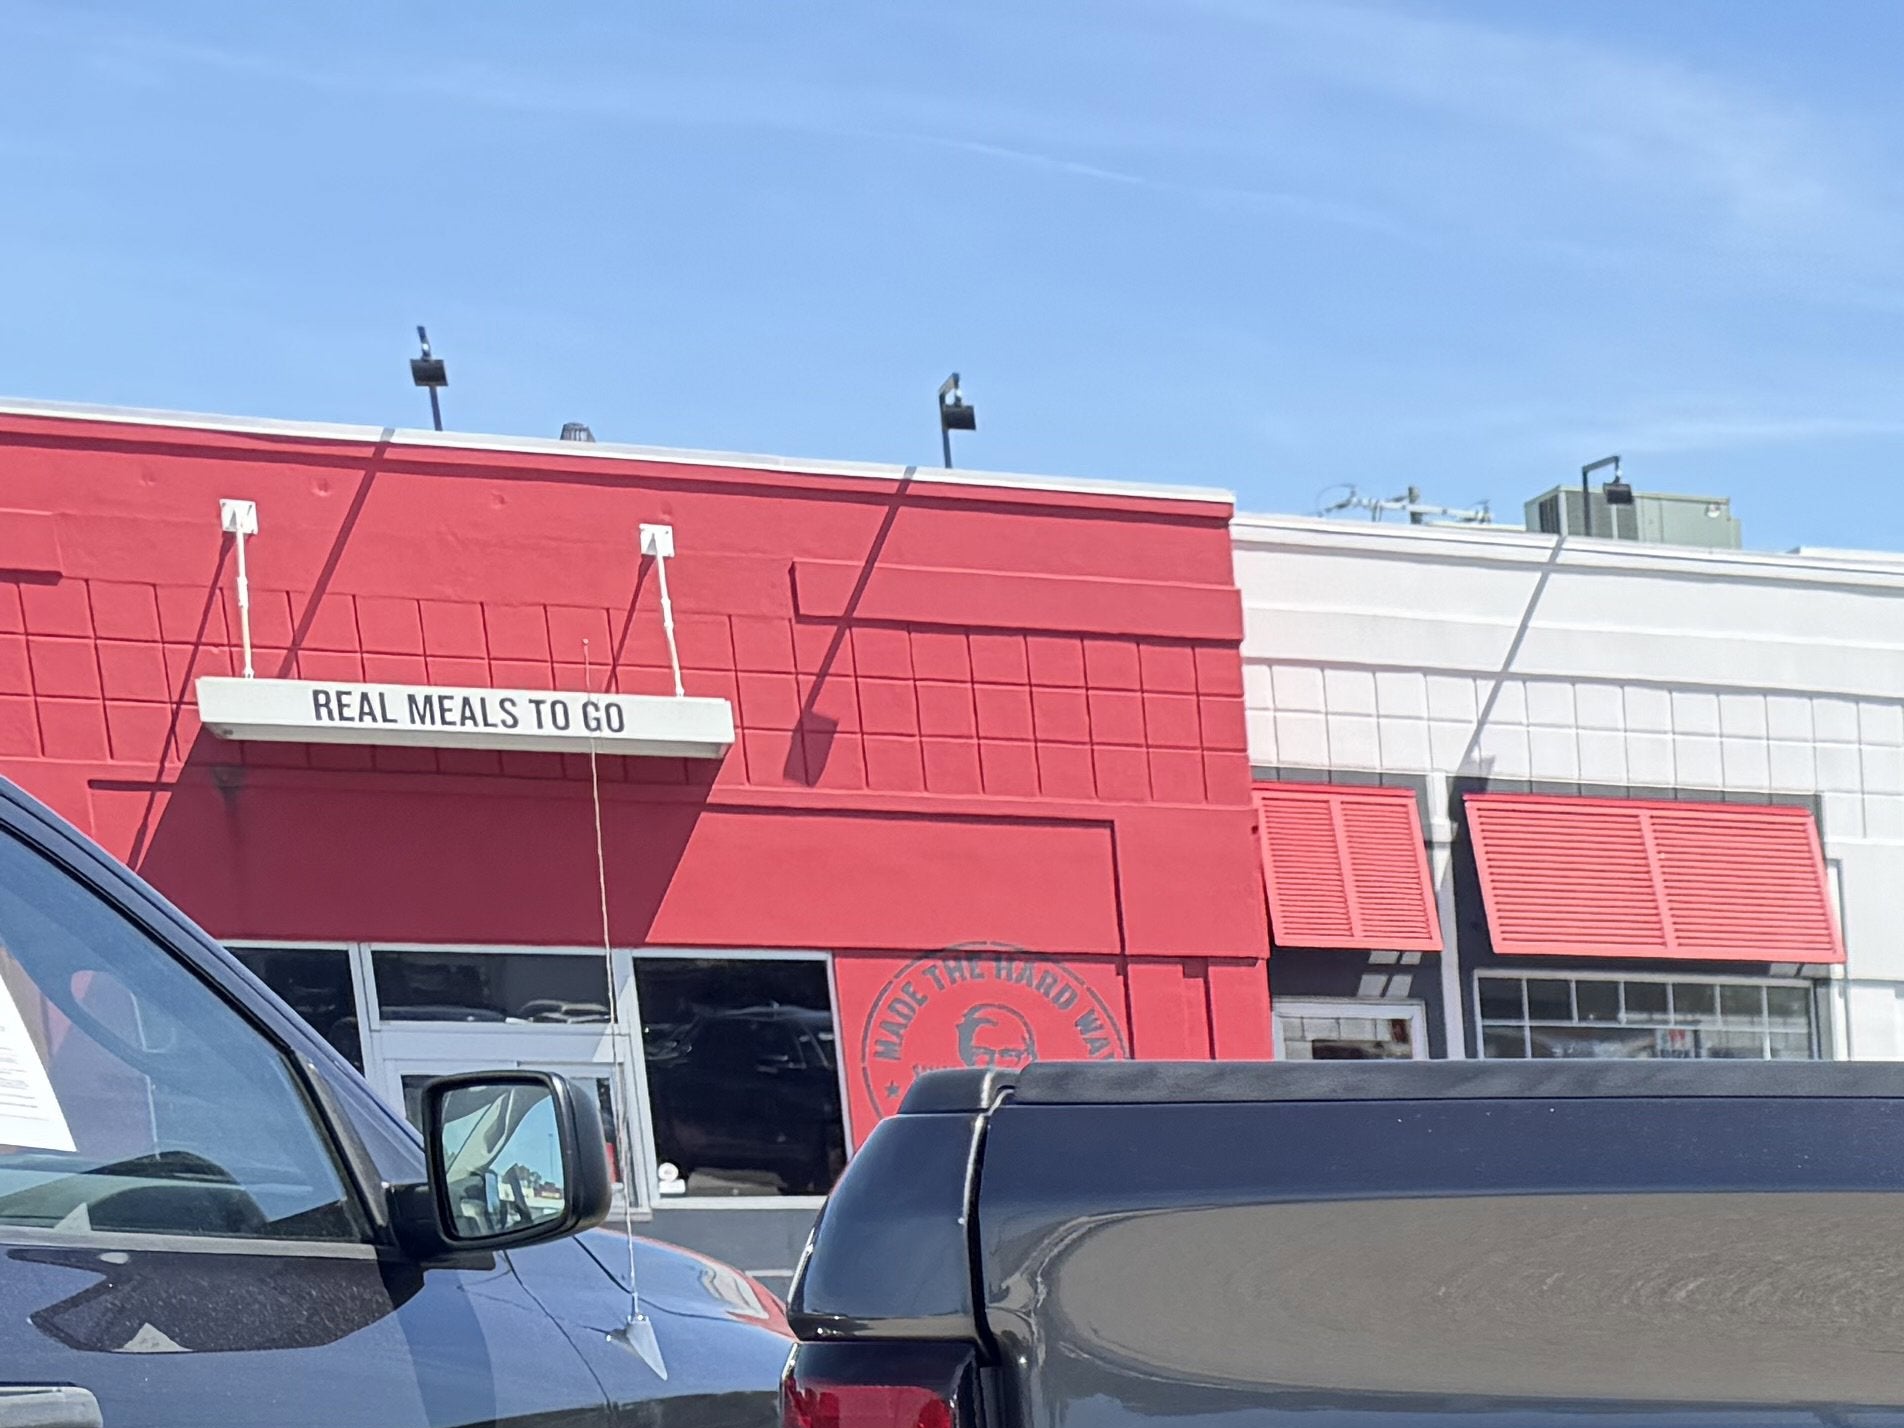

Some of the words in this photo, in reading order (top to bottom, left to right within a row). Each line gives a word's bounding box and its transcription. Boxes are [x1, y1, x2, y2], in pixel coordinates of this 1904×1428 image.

[312, 689, 398, 723] REAL
[407, 693, 519, 729] MEALS
[528, 698, 570, 731] TO
[581, 700, 625, 733] GO
[873, 980, 929, 1060] MADE
[922, 954, 986, 991] THE
[994, 954, 1080, 1011] HARD
[1074, 1008, 1115, 1059] WA
